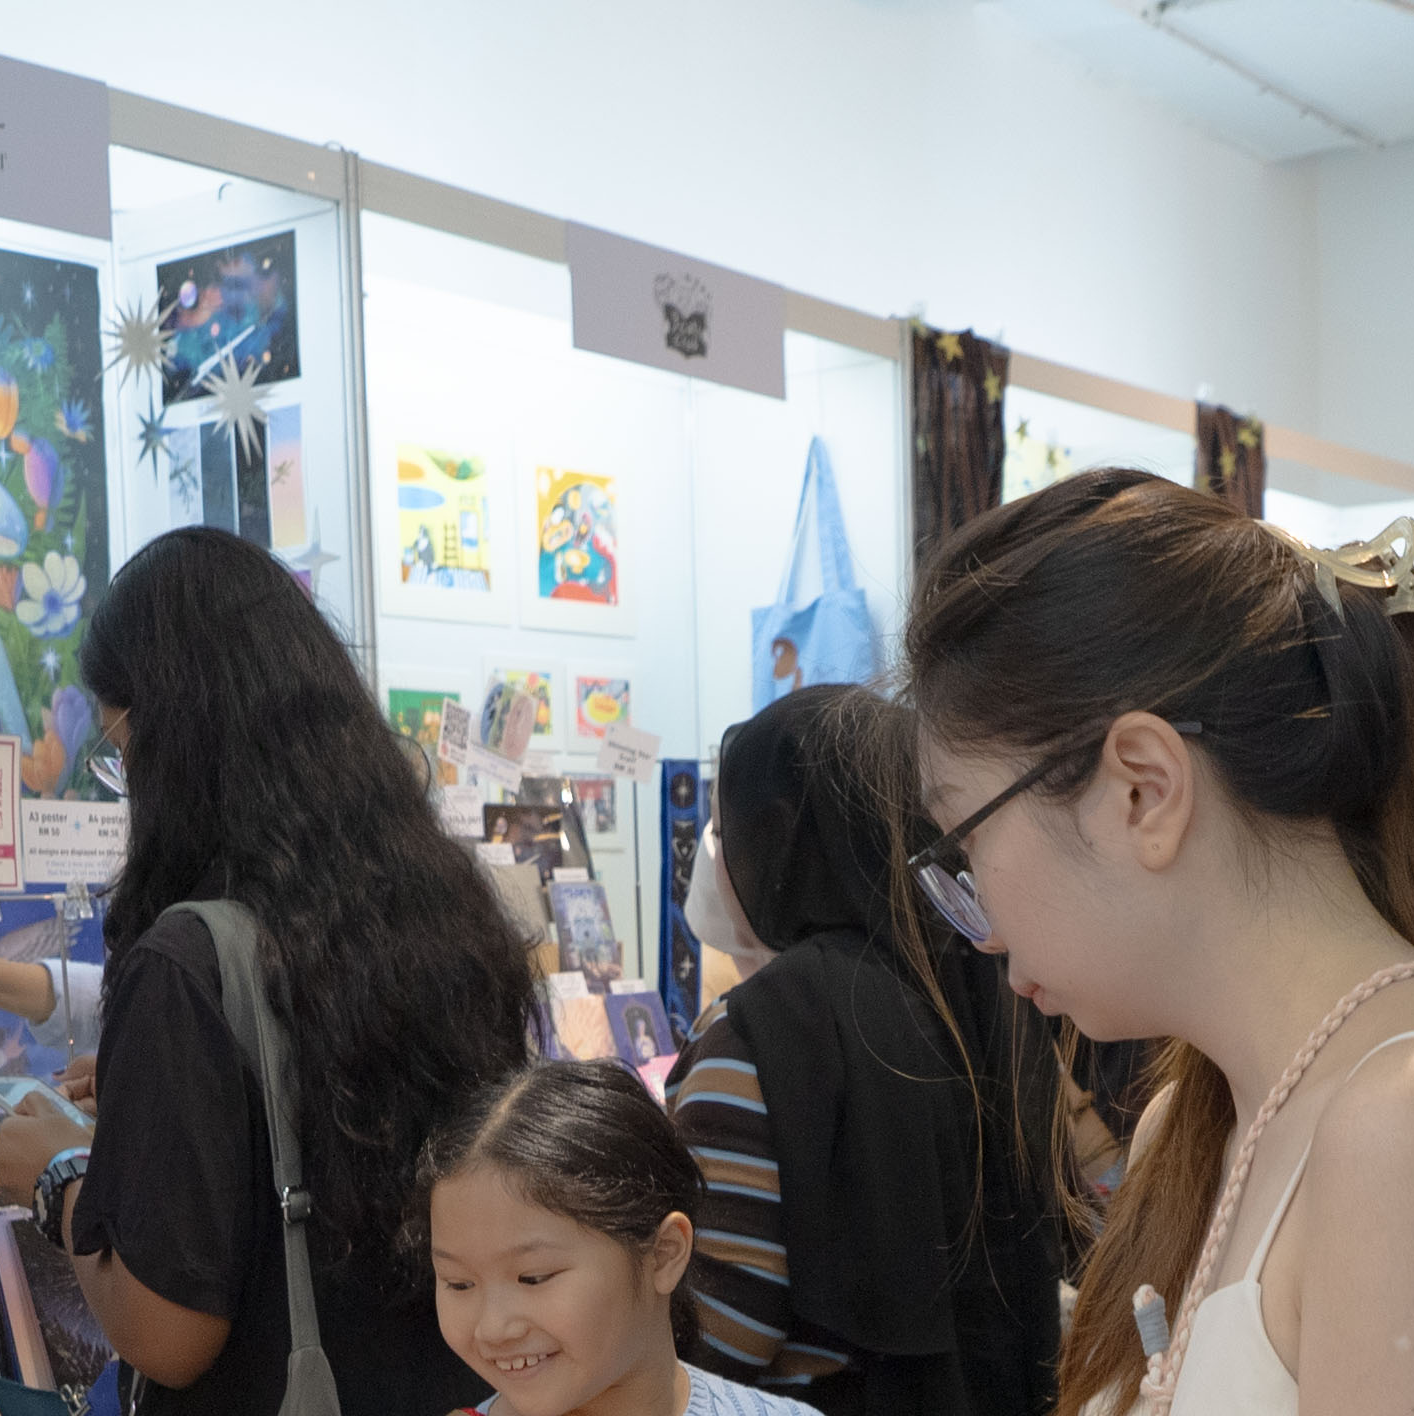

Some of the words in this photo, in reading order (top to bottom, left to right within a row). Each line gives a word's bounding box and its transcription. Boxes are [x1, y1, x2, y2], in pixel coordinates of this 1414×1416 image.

[29, 811, 39, 821] A3
[41, 813, 67, 823] poster
[88, 813, 98, 824] A4
[38, 827, 49, 836] RM
